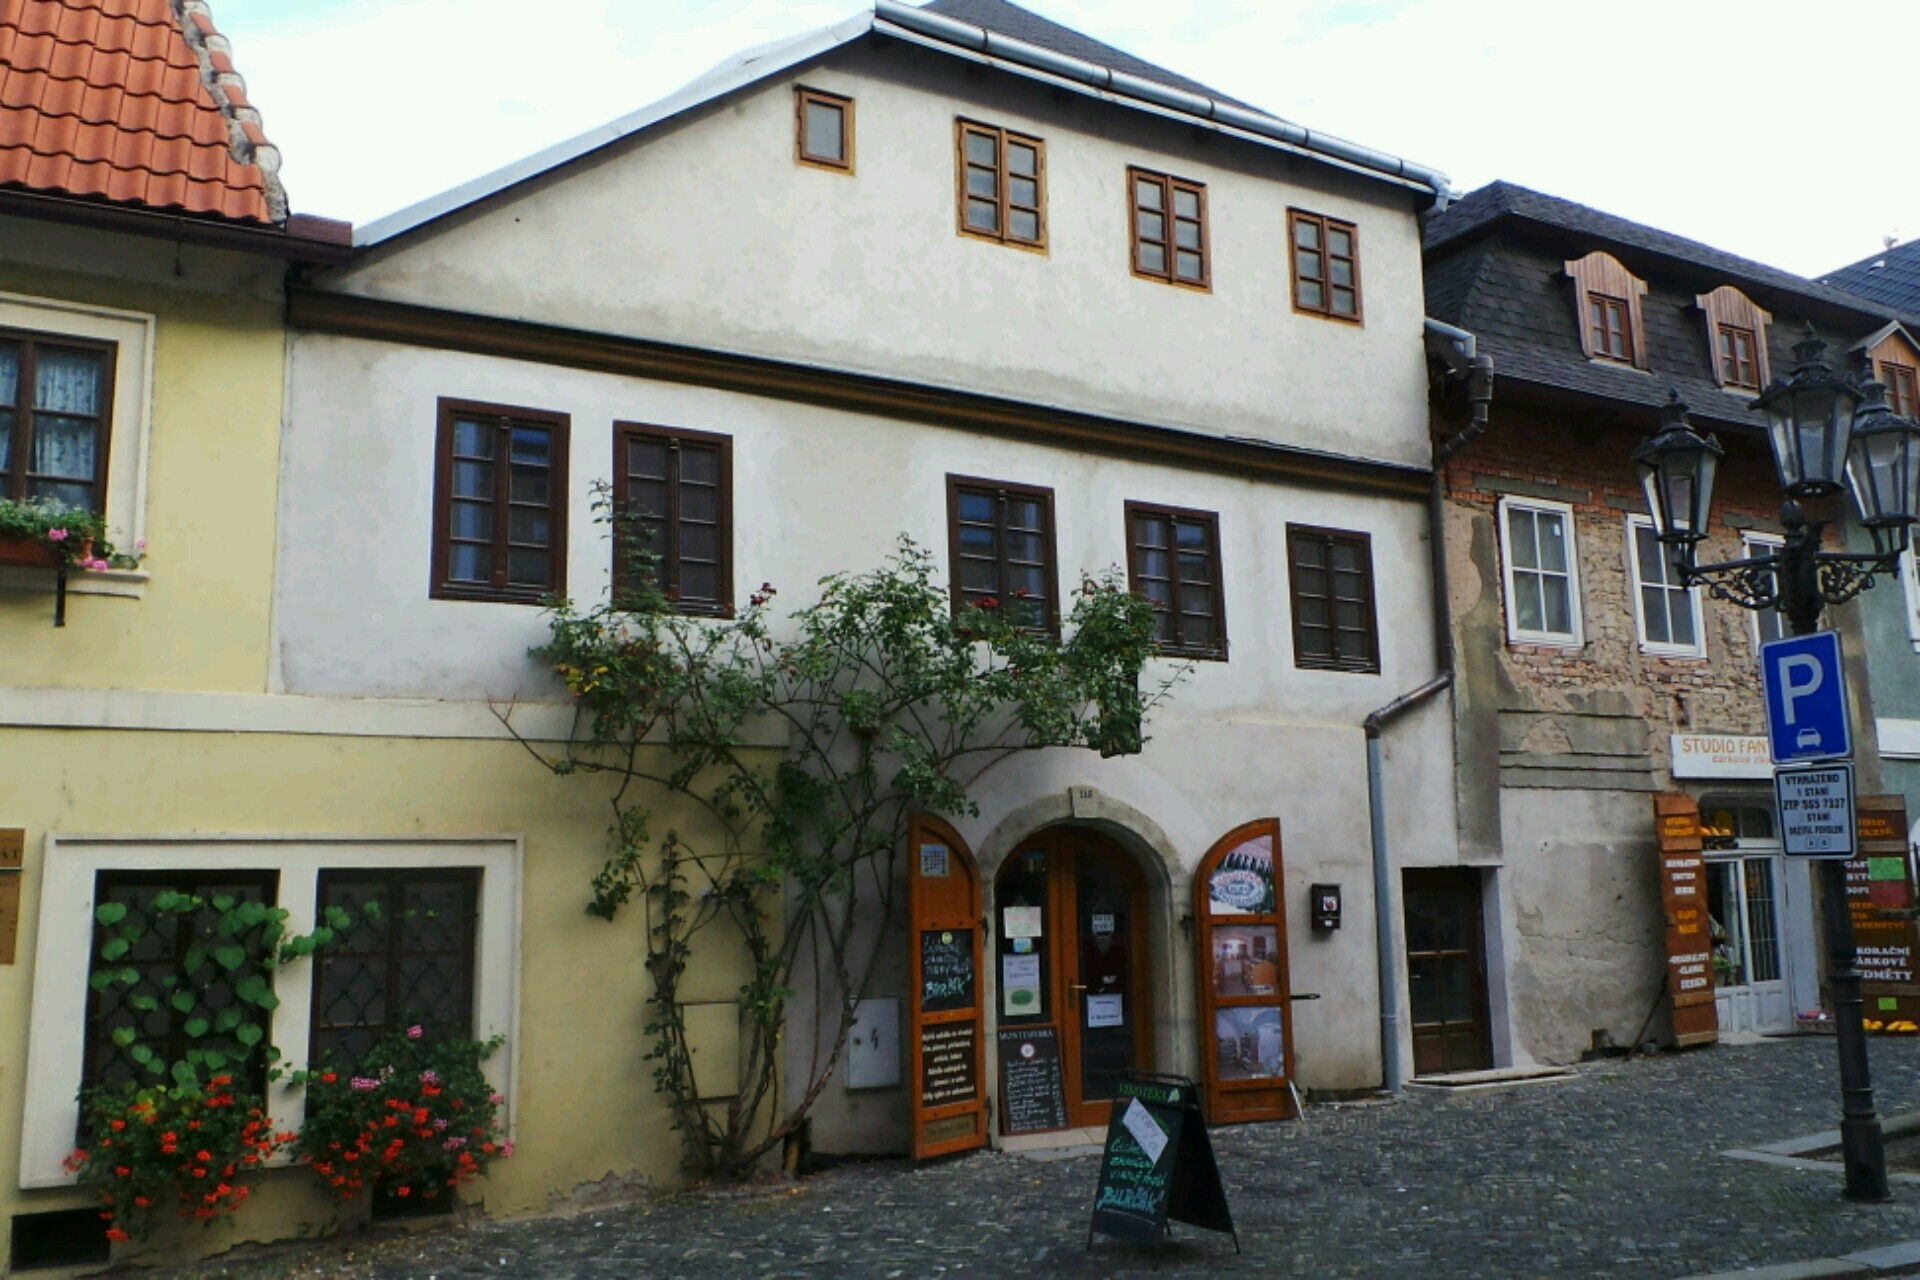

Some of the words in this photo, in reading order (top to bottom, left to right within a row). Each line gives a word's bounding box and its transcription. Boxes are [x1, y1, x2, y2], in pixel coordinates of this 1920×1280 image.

[1777, 653, 1824, 726] P
[1682, 737, 1736, 753] STUDIO
[1785, 773, 1840, 785] VYHRAZENO
